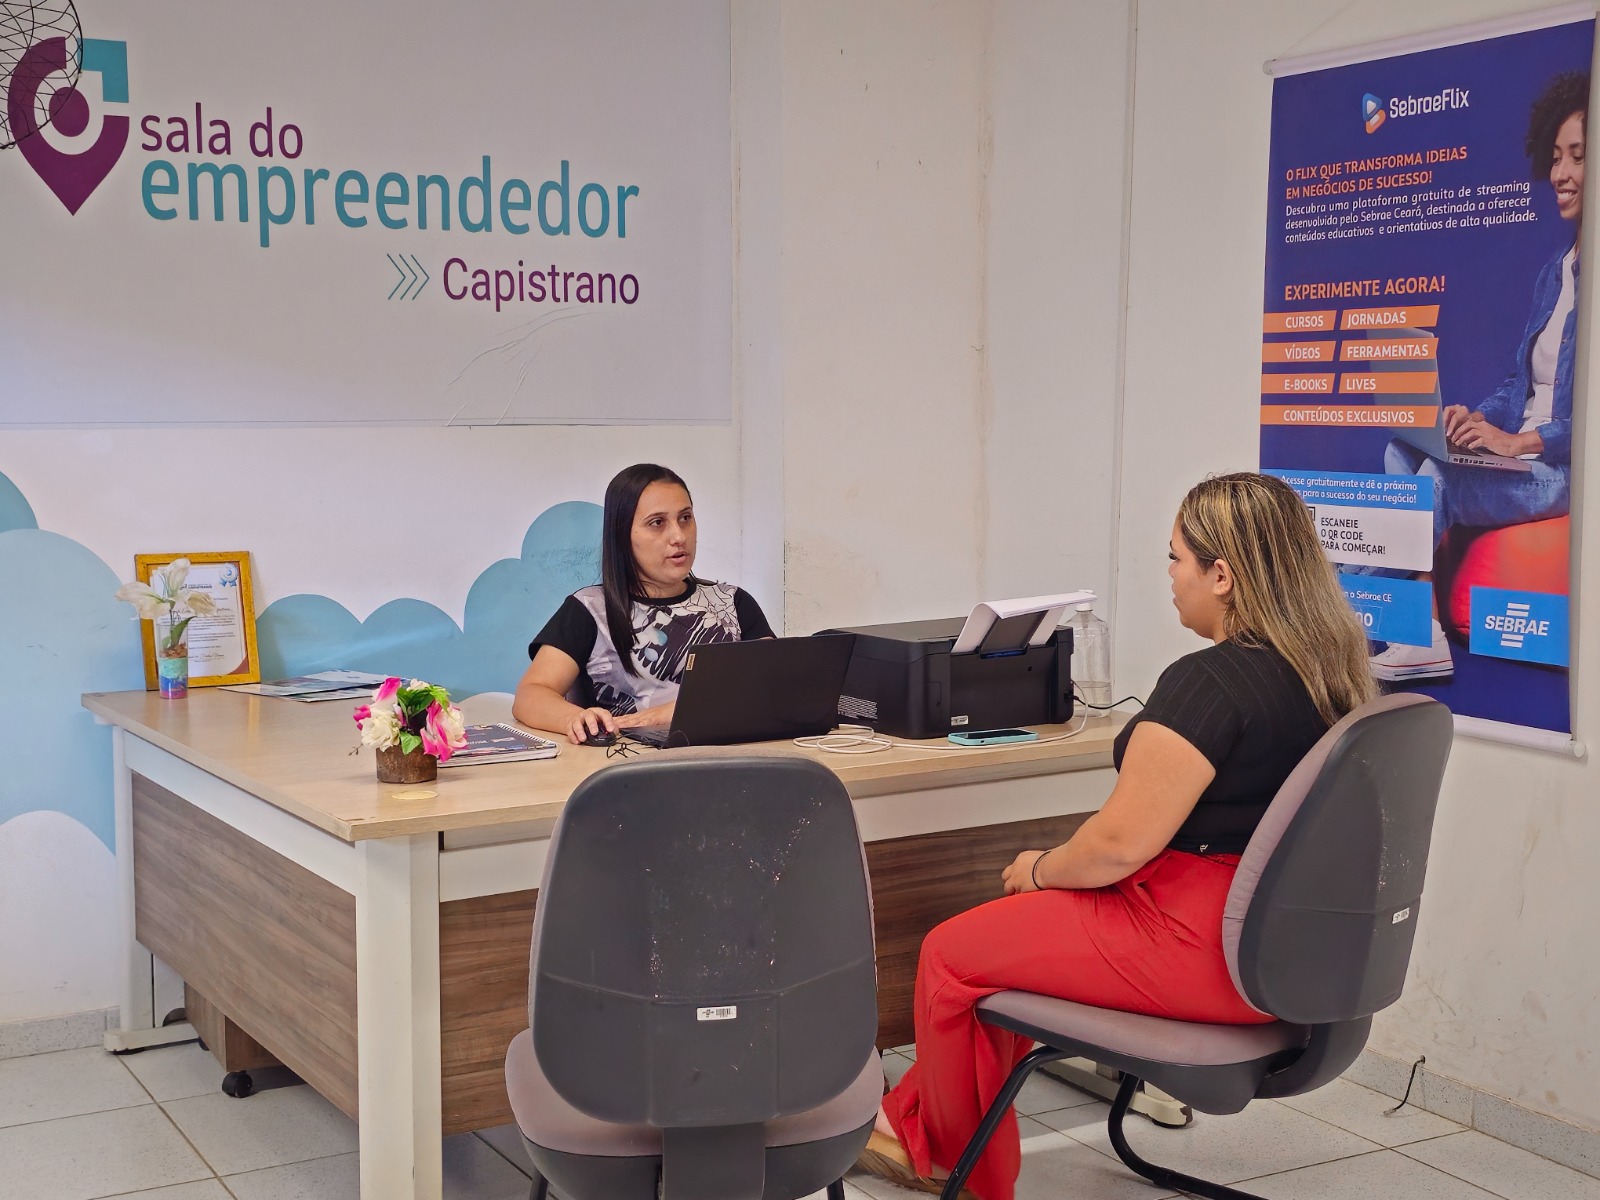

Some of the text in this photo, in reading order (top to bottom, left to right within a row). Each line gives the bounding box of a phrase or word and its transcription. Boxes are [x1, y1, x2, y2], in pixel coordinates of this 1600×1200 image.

[1390, 88, 1469, 118] SebraeFlix
[140, 102, 303, 159] sala do
[1286, 146, 1468, 181] O FLIX QUE TRANSFORMA IDEIAS
[1286, 171, 1432, 199] EM NEGÓCIOS DE SUCESSO!
[141, 155, 640, 248] empreendedor
[1286, 180, 1530, 216] Descubra uma plataforma gratuita de streaming
[1340, 213, 1359, 227] pelo
[1361, 210, 1391, 222] Sebrae
[1394, 206, 1424, 219] Ceará,
[1427, 201, 1475, 215] destinada
[1478, 202, 1485, 210] a
[1488, 196, 1531, 209] oferecer
[1285, 210, 1538, 243] conteúdos educativos e orientativos de alta qualidade.
[443, 257, 640, 312] Capistrano
[1285, 275, 1446, 300] EXPERIMENTE AGORA!
[1285, 315, 1324, 328] CURSOS
[1347, 311, 1406, 328] JORNADAS
[1285, 344, 1321, 359] VÍDEOS
[1347, 344, 1429, 358] FERRAMENTAS
[1284, 379, 1328, 391] E-BOOKS
[1346, 378, 1376, 391] LIVES
[1283, 406, 1414, 424] CONTEÚDOS EXCLUSIVOS
[1307, 477, 1359, 489] gratuitamente
[1366, 479, 1376, 489] dê
[1384, 479, 1417, 491] próximo
[1303, 490, 1320, 499] para
[1326, 492, 1354, 500] sucesso
[1356, 491, 1365, 500] do
[1382, 493, 1417, 504] negócio!
[1321, 517, 1359, 529] ESCANEIE
[1321, 529, 1363, 541] O QR CODE
[1321, 540, 1386, 555] PARA COMEÇAR!
[1356, 591, 1381, 601] Sebrae
[1383, 593, 1392, 602] CE
[1485, 615, 1550, 636] SEBRAE
